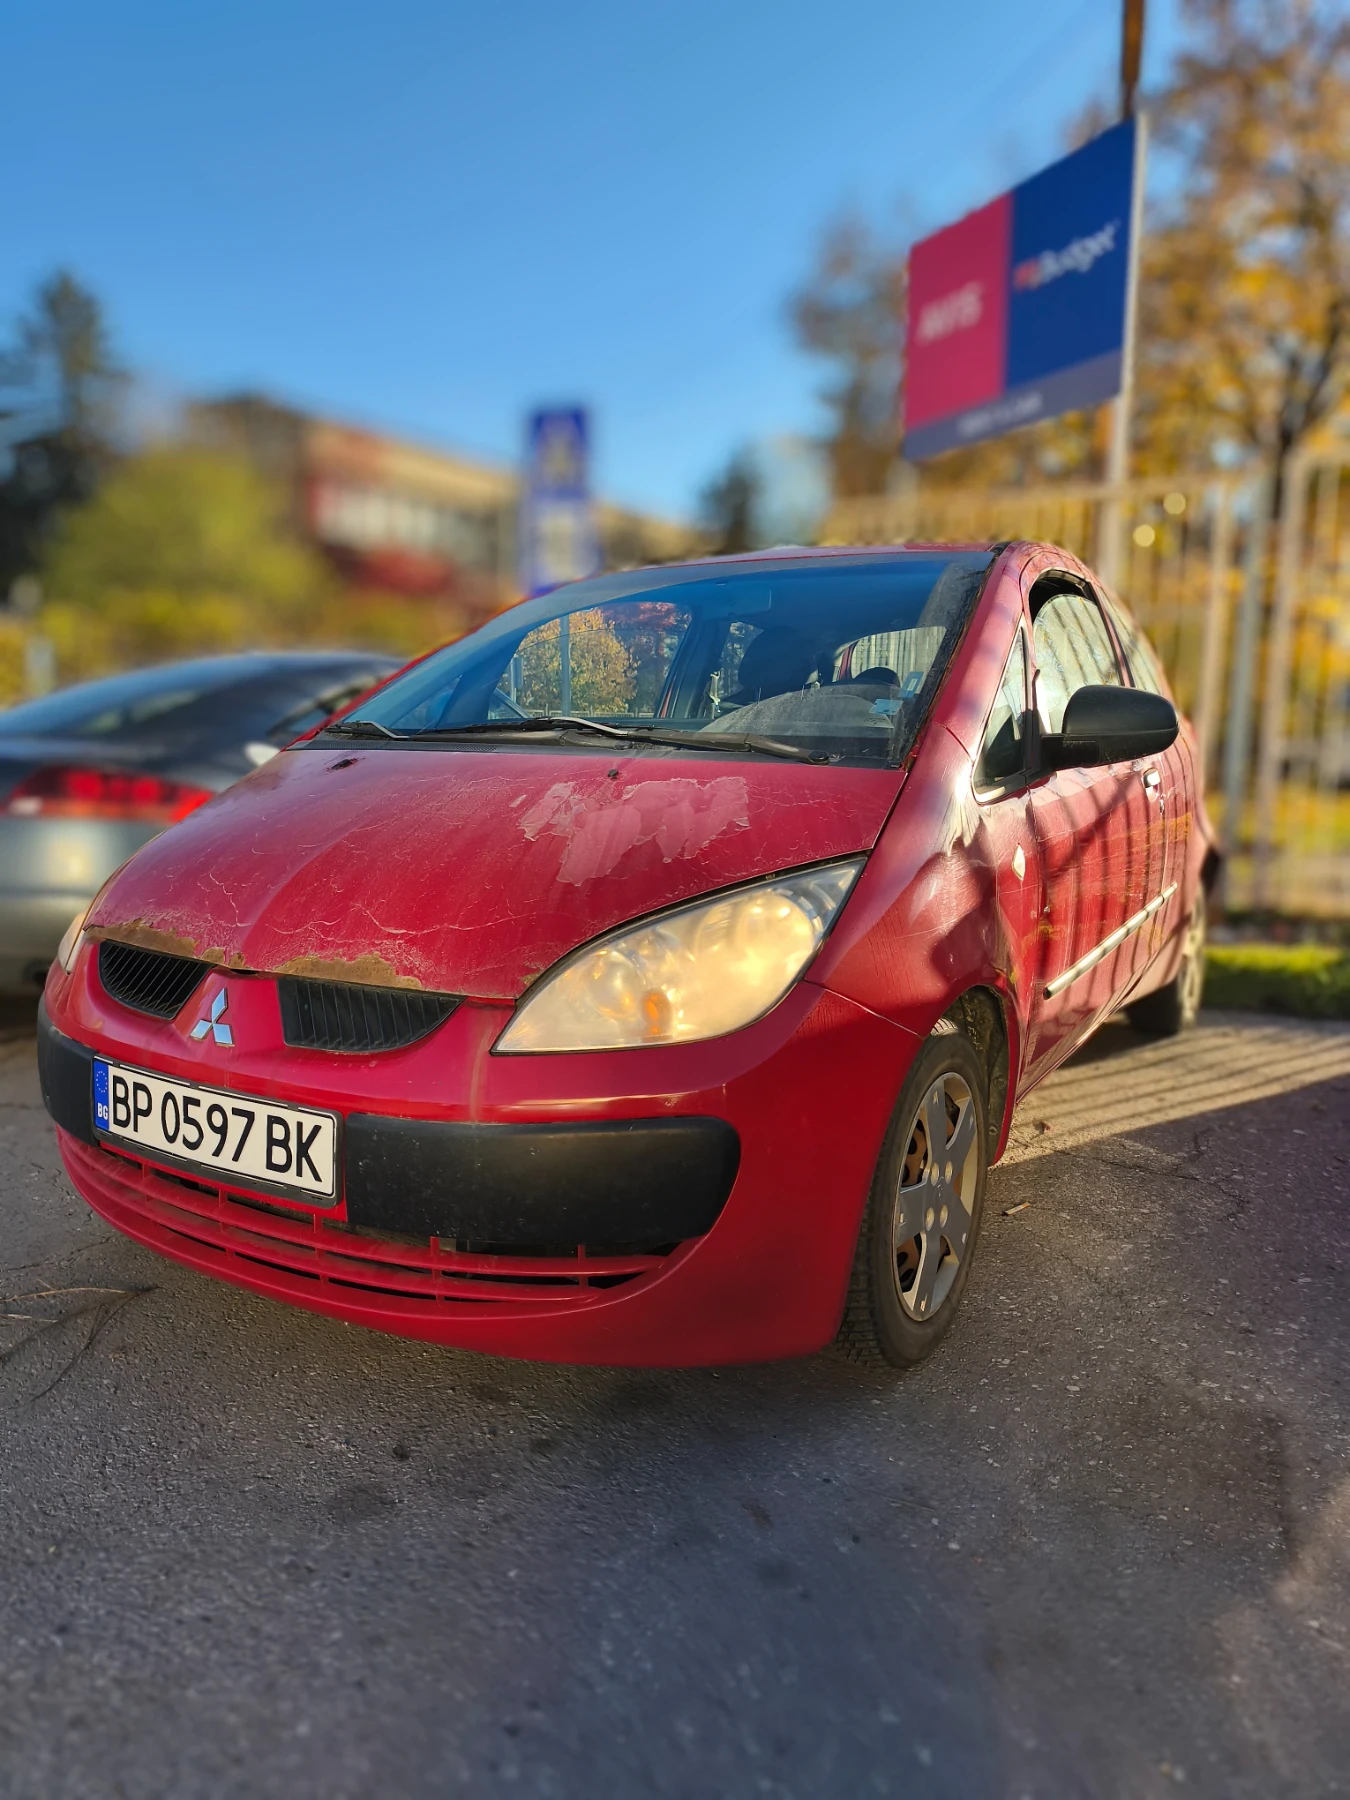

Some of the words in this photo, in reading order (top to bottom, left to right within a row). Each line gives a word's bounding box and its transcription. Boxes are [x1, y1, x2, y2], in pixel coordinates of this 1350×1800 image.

[97, 1102, 109, 1120] BG
[112, 1074, 153, 1133] BP
[161, 1091, 255, 1162] 0597
[266, 1114, 323, 1183] BK
